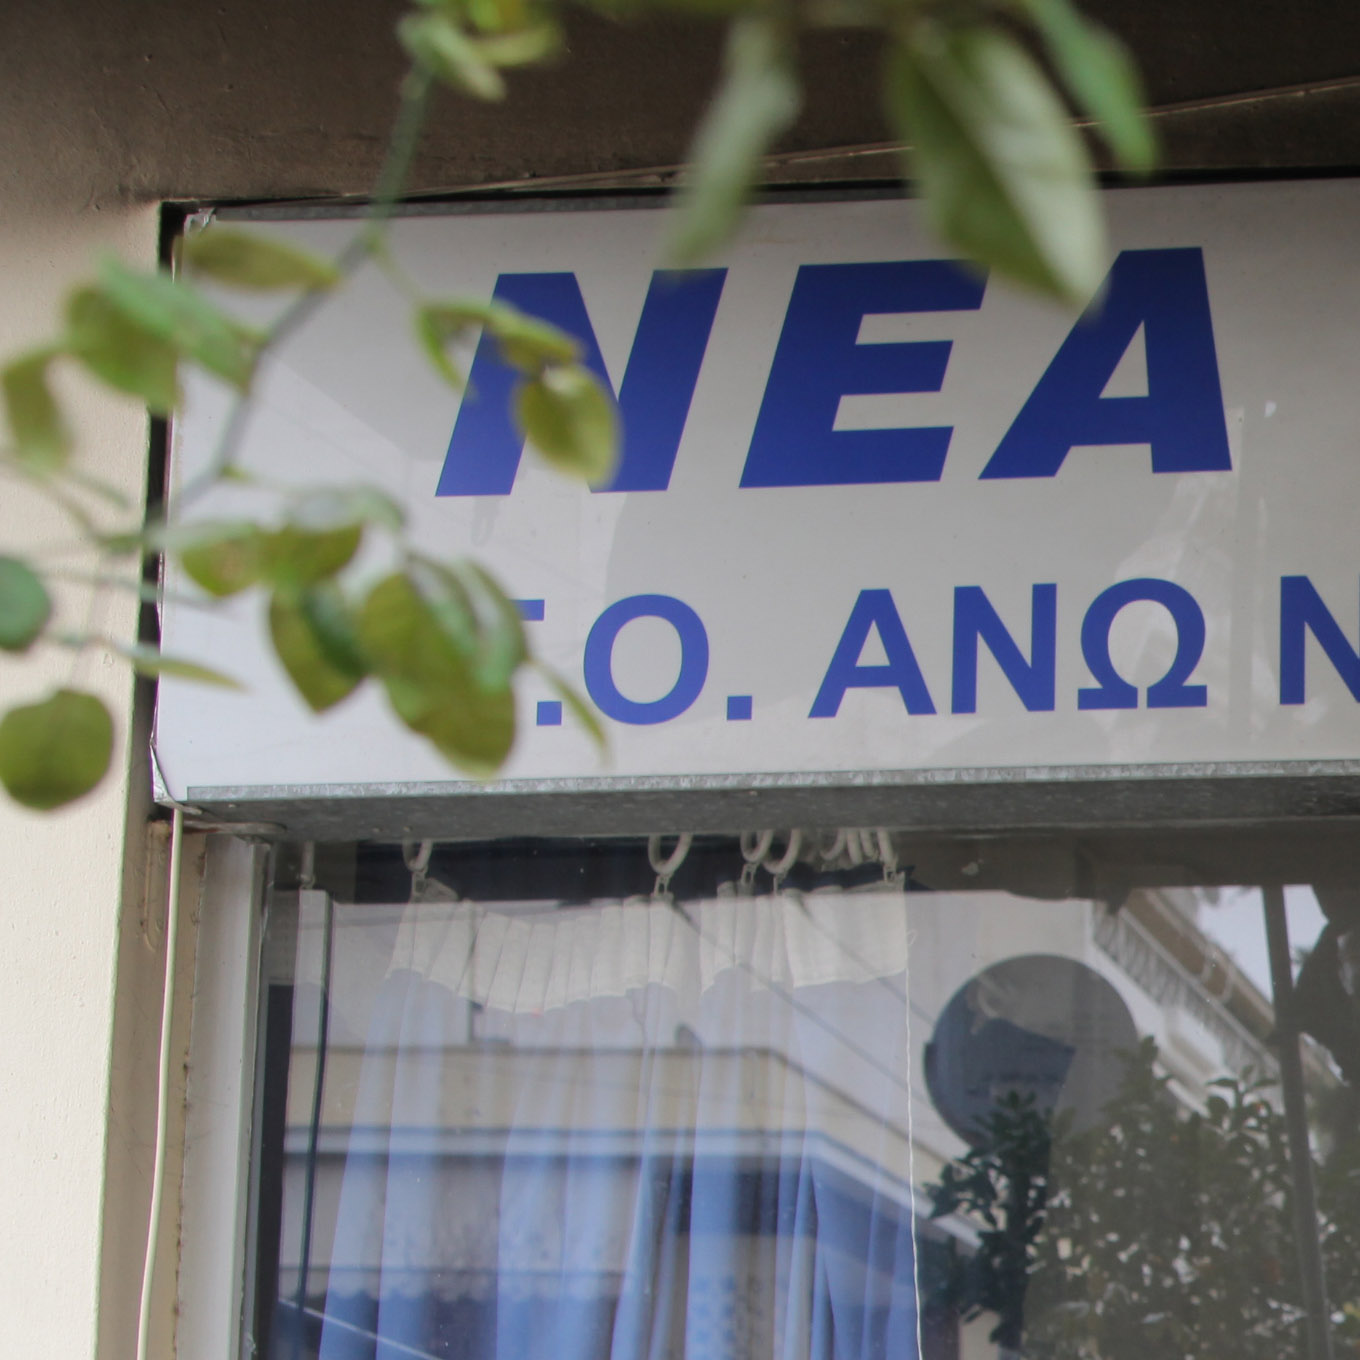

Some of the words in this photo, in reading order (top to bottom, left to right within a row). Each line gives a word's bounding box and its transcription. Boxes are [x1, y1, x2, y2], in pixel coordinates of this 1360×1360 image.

[435, 246, 1233, 497] ΝΕΑ
[508, 593, 753, 727] .Ο.
[808, 577, 1208, 719] ΑΝΩ
